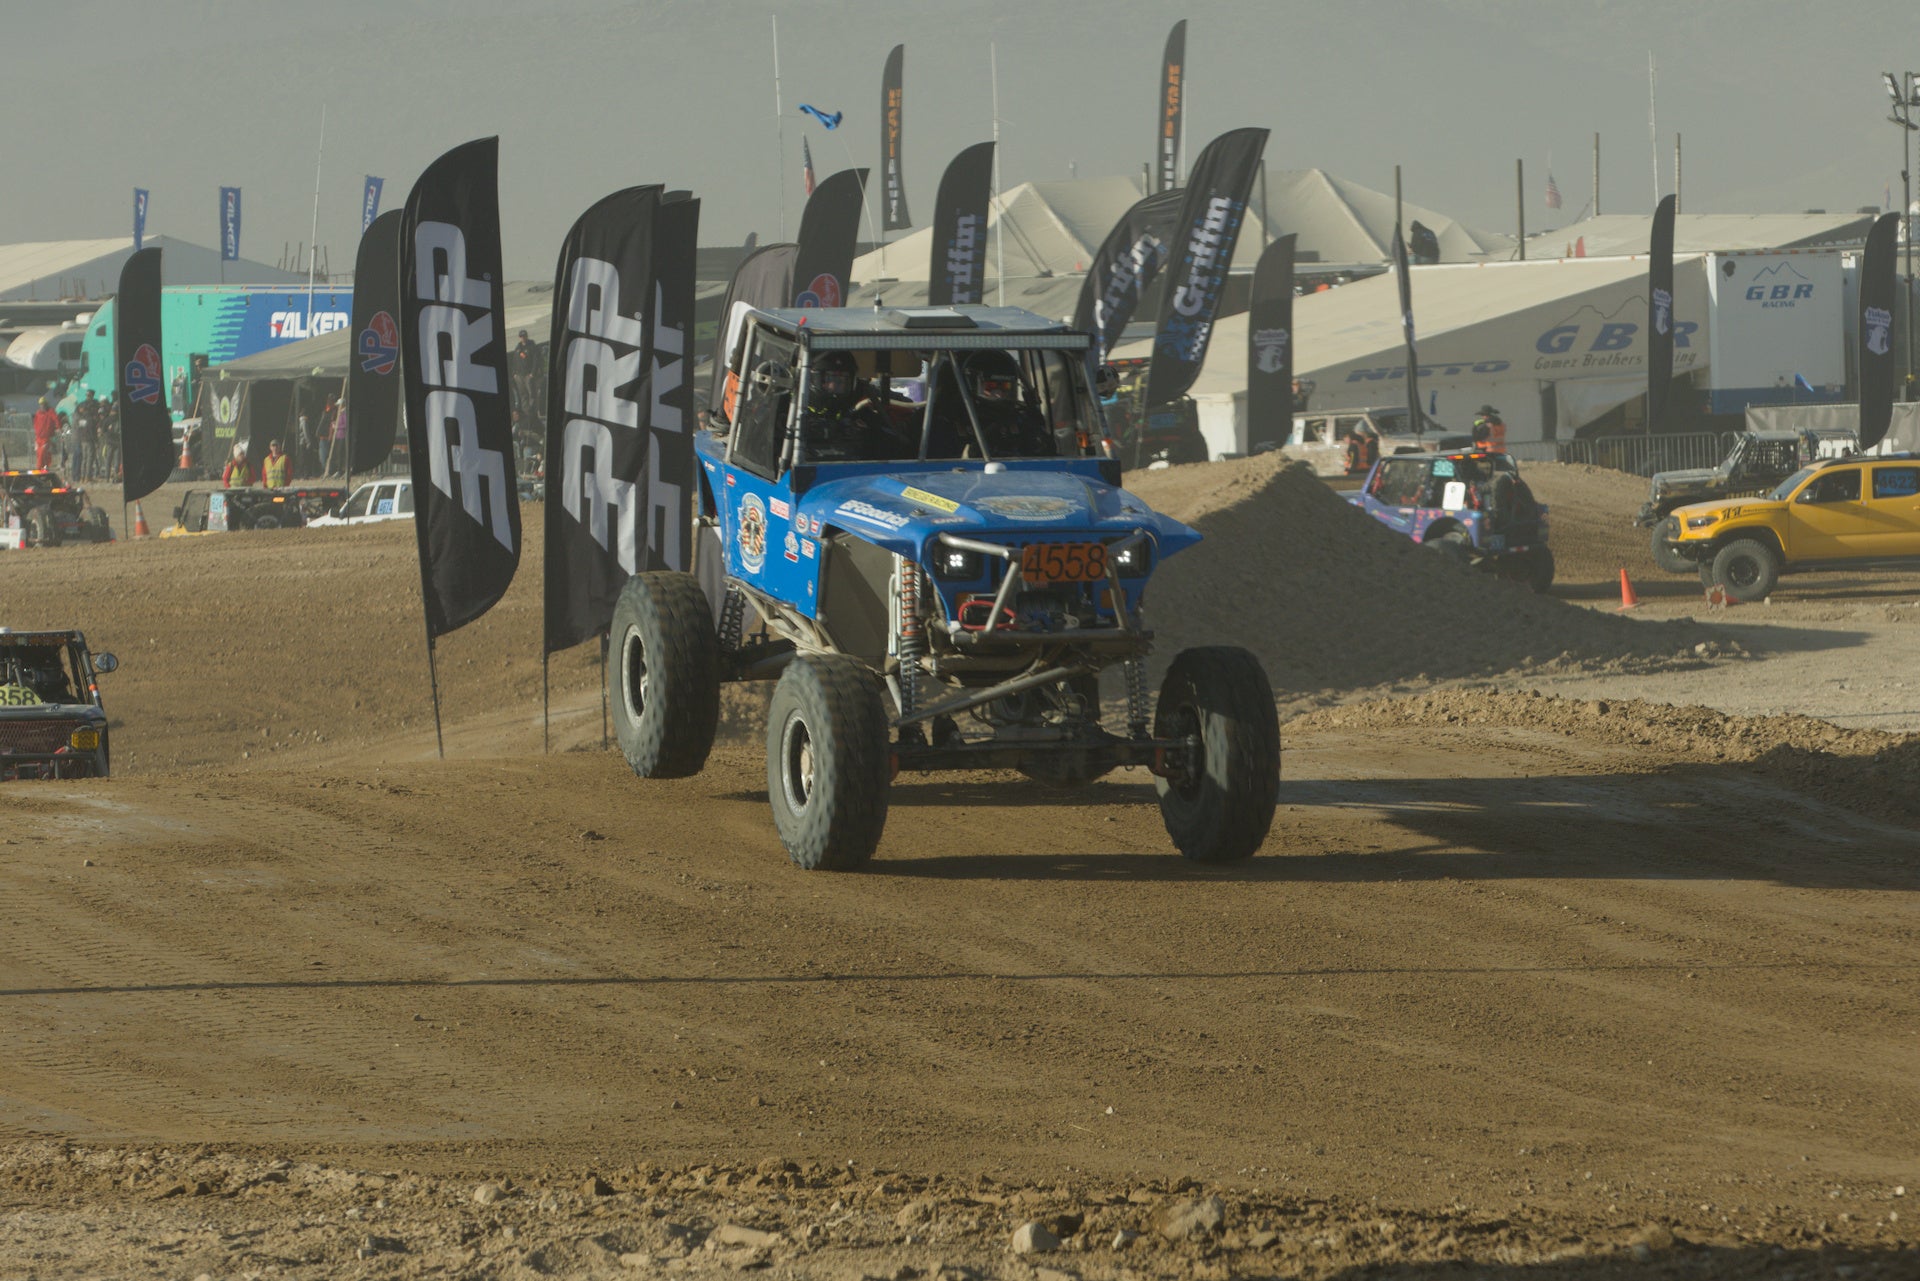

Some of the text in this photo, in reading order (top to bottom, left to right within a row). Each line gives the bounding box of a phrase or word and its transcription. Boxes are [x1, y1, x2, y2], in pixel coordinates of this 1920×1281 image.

[226, 191, 237, 258] FALKEN
[947, 213, 976, 304] riffin
[1173, 196, 1232, 317] Griffin
[269, 311, 349, 339] FALKEN
[1762, 301, 1796, 309] RACING
[358, 328, 398, 373] VP
[1534, 356, 1578, 371] Gomez
[1582, 352, 1643, 367] Brothers
[125, 360, 161, 403] VP
[415, 220, 514, 555] PRP
[562, 256, 642, 576] PRP
[1879, 474, 1916, 490] 4622
[1024, 545, 1105, 580] 4558
